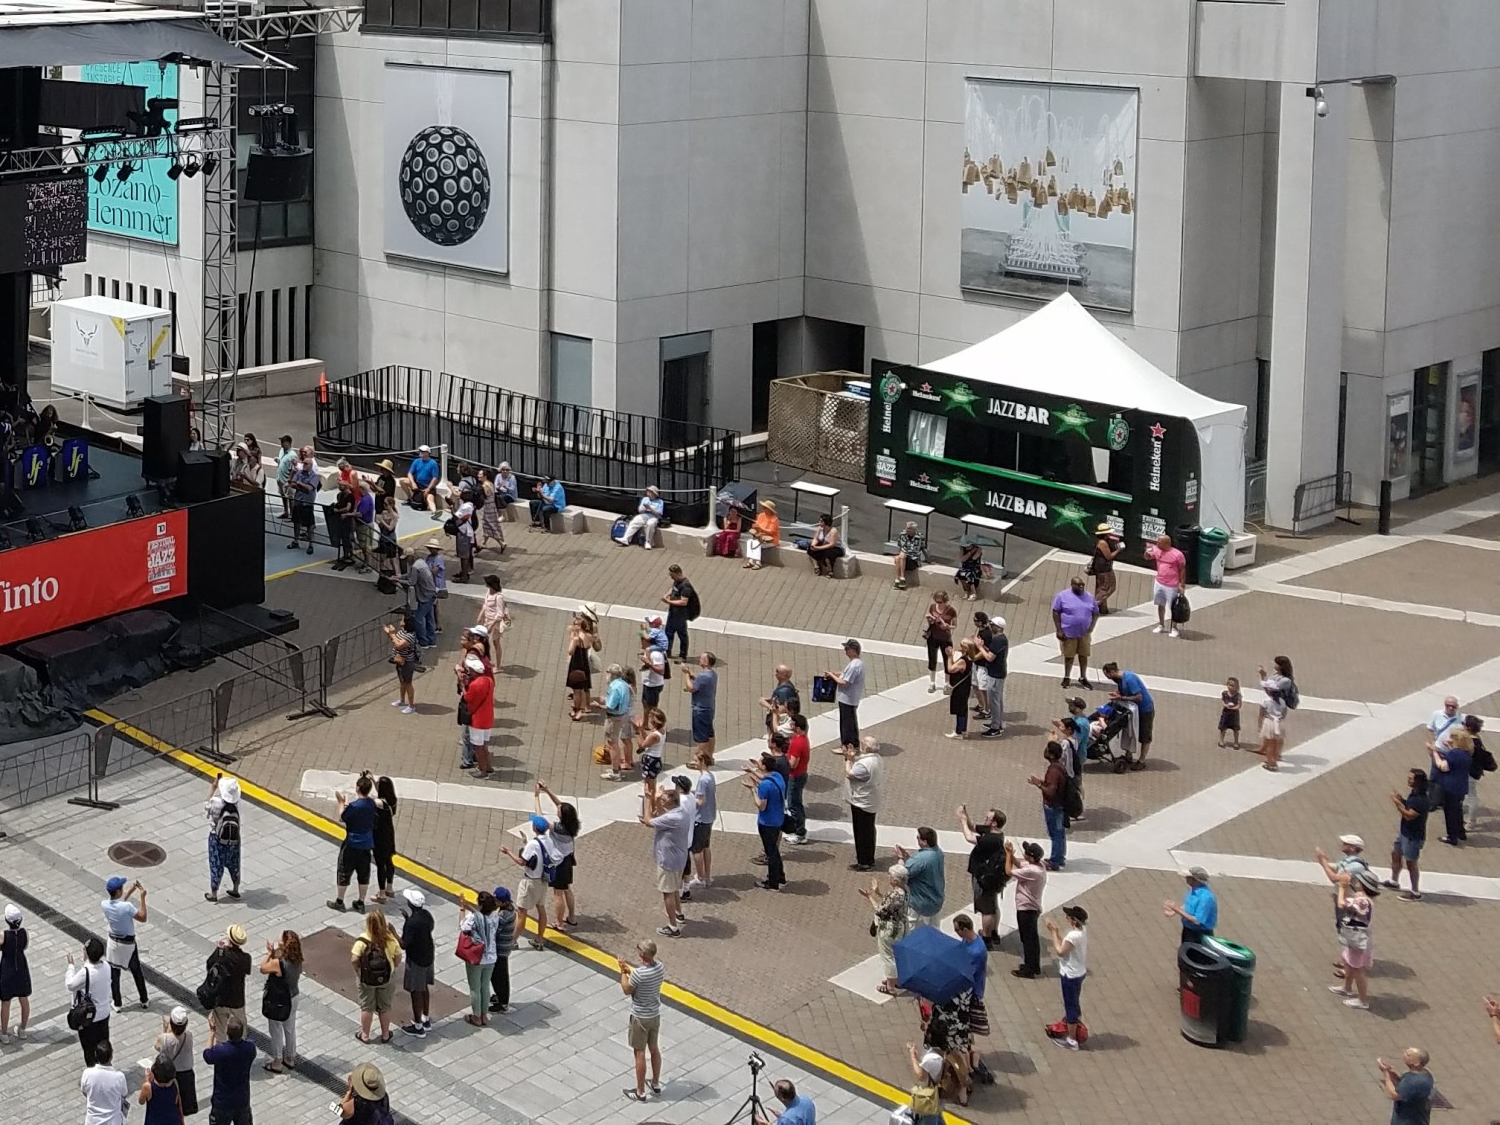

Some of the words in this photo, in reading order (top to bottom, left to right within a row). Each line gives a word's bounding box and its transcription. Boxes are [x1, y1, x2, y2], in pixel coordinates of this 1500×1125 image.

[88, 197, 173, 236] Hemmer
[1149, 439, 1162, 492] Heineken
[1141, 522, 1166, 536] JAZZ
[147, 548, 176, 569] JAZZ
